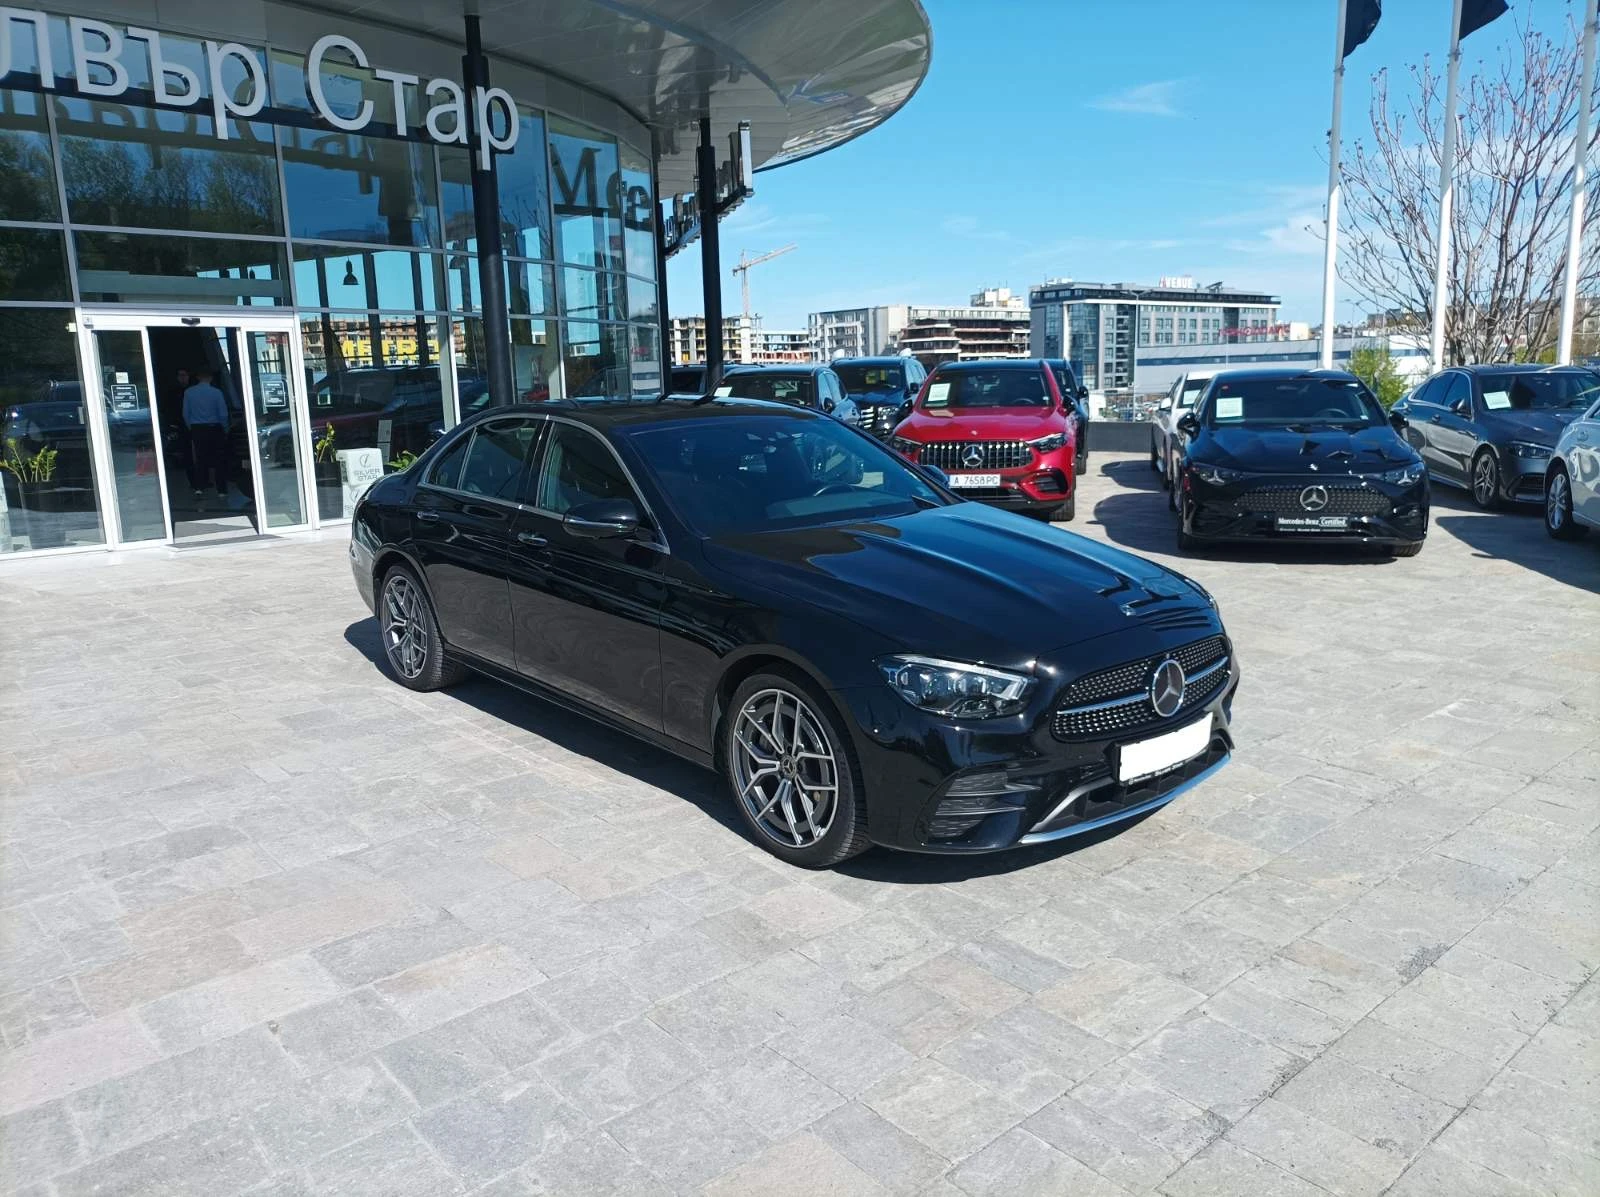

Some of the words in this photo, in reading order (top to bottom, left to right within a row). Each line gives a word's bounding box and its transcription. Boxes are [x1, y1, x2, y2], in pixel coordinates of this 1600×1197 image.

[306, 34, 520, 171] Стар
[1278, 517, 1319, 525] Mercedes-Benz
[1320, 517, 1346, 526] Certified
